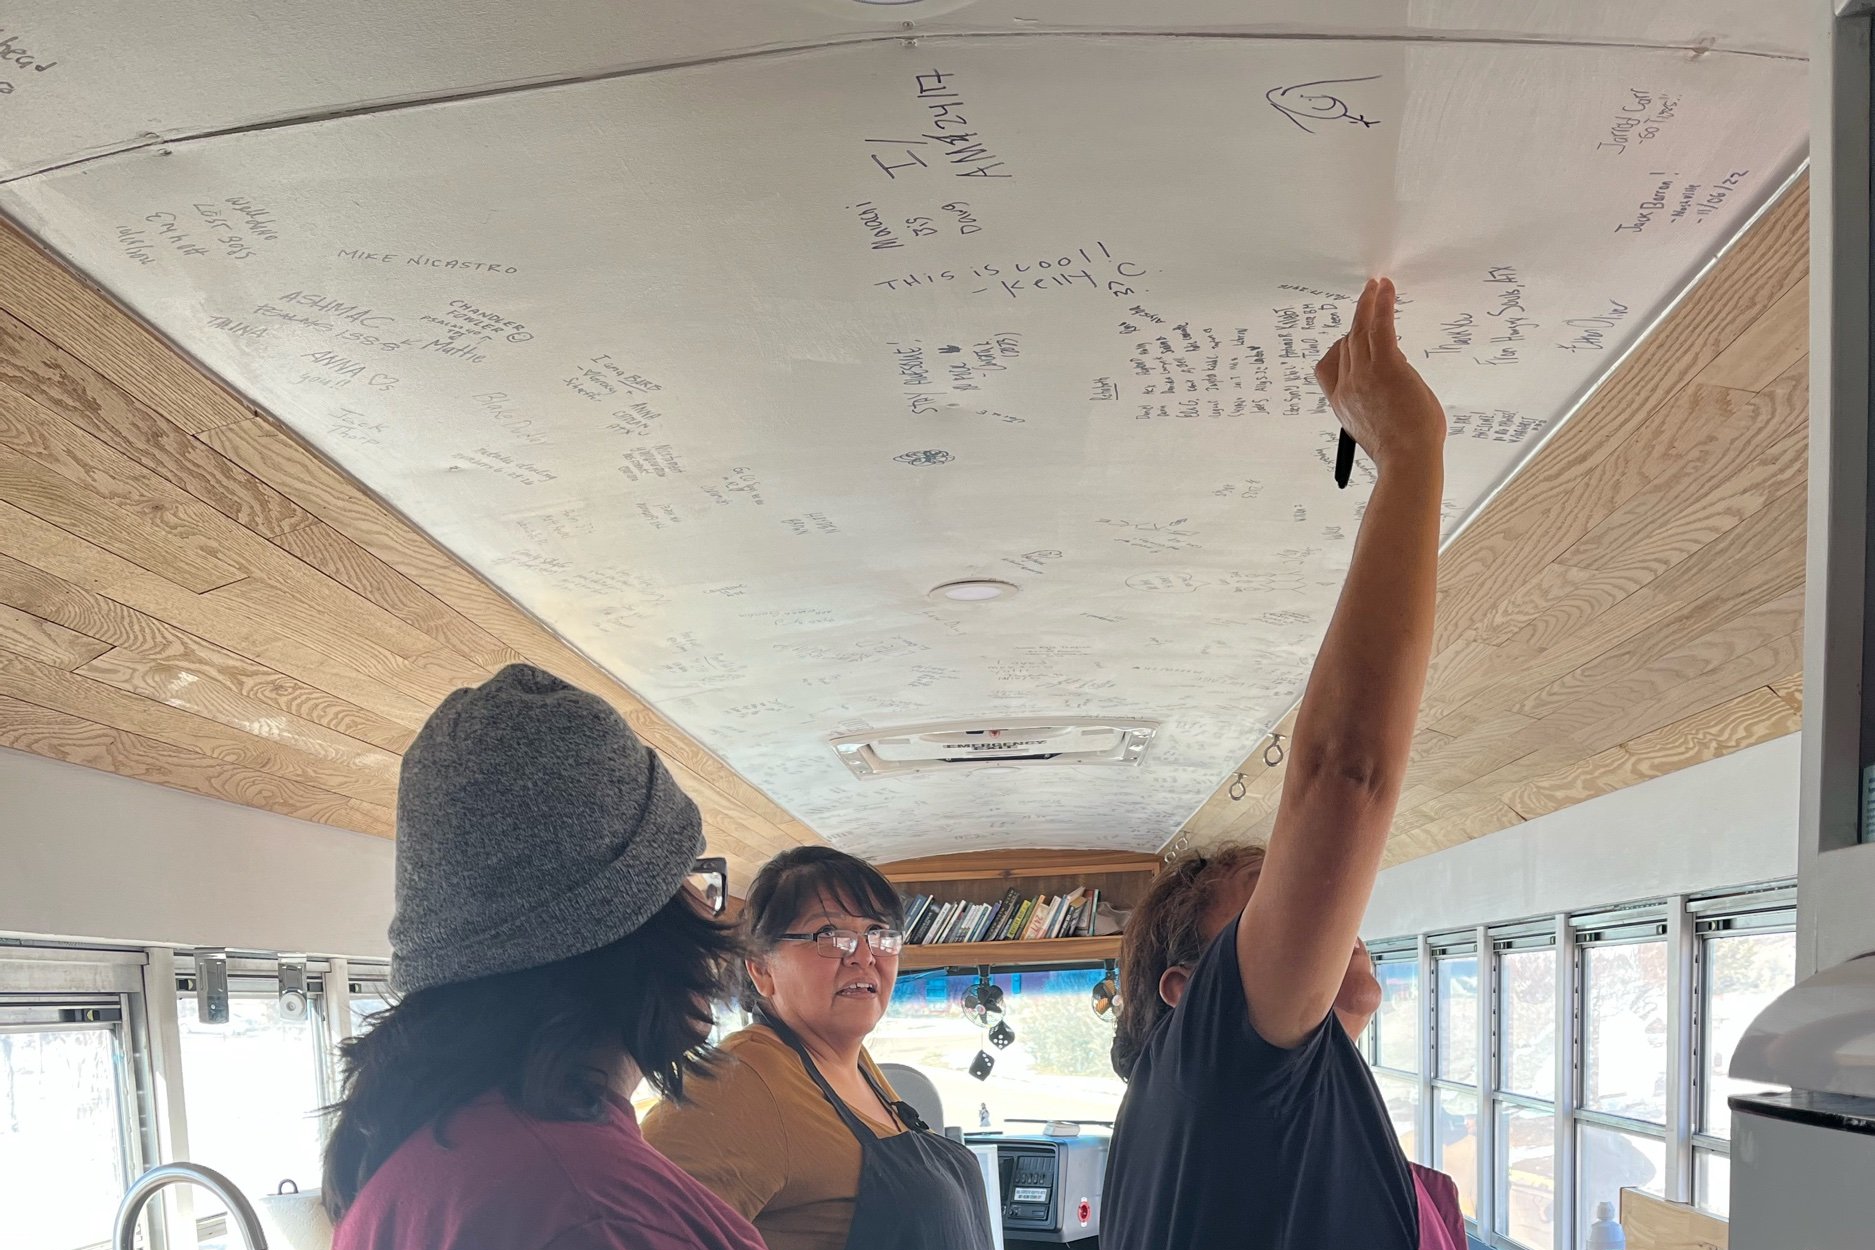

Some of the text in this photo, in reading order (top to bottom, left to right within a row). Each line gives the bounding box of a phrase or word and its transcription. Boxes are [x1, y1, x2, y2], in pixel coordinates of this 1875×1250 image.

[338, 250, 518, 274] MIKE NICASTRO
[447, 310, 504, 333] FOWLER
[449, 300, 526, 331] CHANDLER
[943, 740, 1047, 749] EMERGENCY
